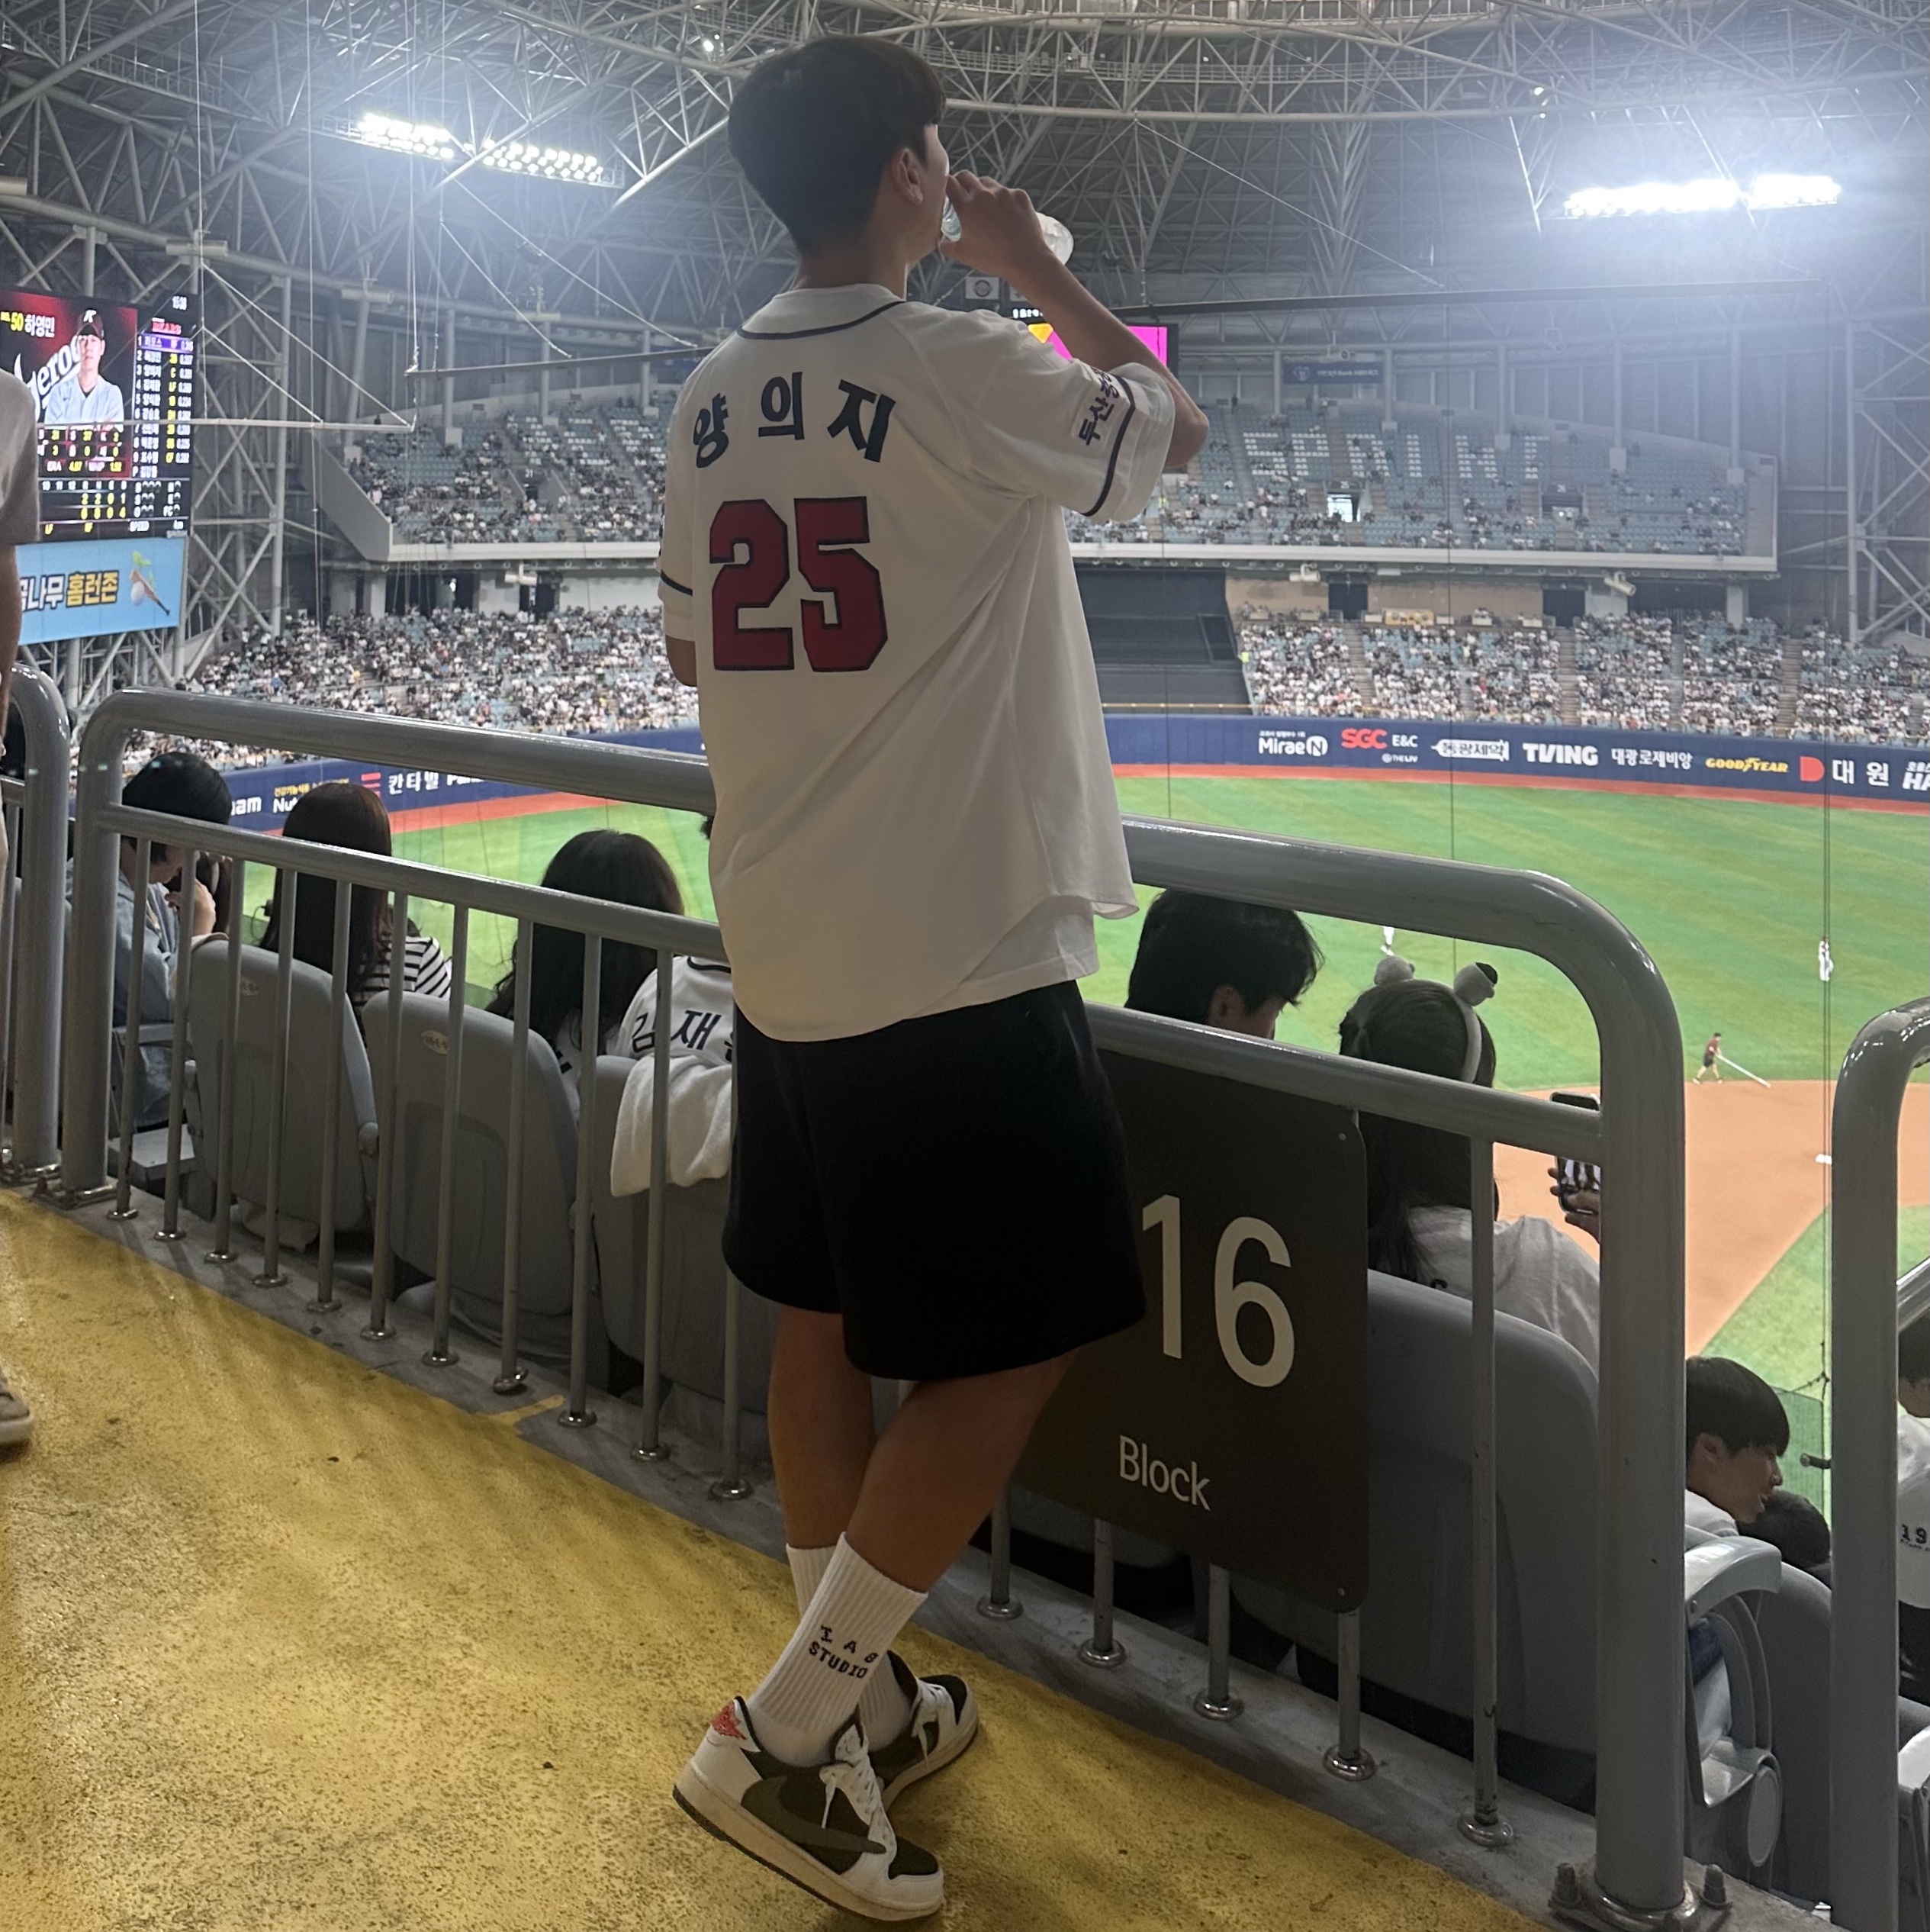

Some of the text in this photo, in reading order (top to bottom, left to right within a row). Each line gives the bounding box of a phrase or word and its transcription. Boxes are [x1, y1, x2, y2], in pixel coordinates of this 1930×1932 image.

[11, 312, 24, 331] 50
[24, 314, 55, 337] 하영민
[83, 309, 96, 323] K
[693, 372, 896, 469] 양의지
[66, 570, 119, 607] 홈런존
[709, 496, 888, 672] 25
[1259, 736, 1328, 757] MiraeN
[1341, 728, 1418, 749] SGC E&C
[1523, 742, 1598, 766] TVING
[1611, 748, 1693, 770] 대광로제비앙
[1705, 757, 1789, 773] GOODYEAR
[1142, 1194, 1295, 1388] 16
[1119, 1435, 1211, 1512] Block
[809, 1641, 868, 1679] STUDIO
